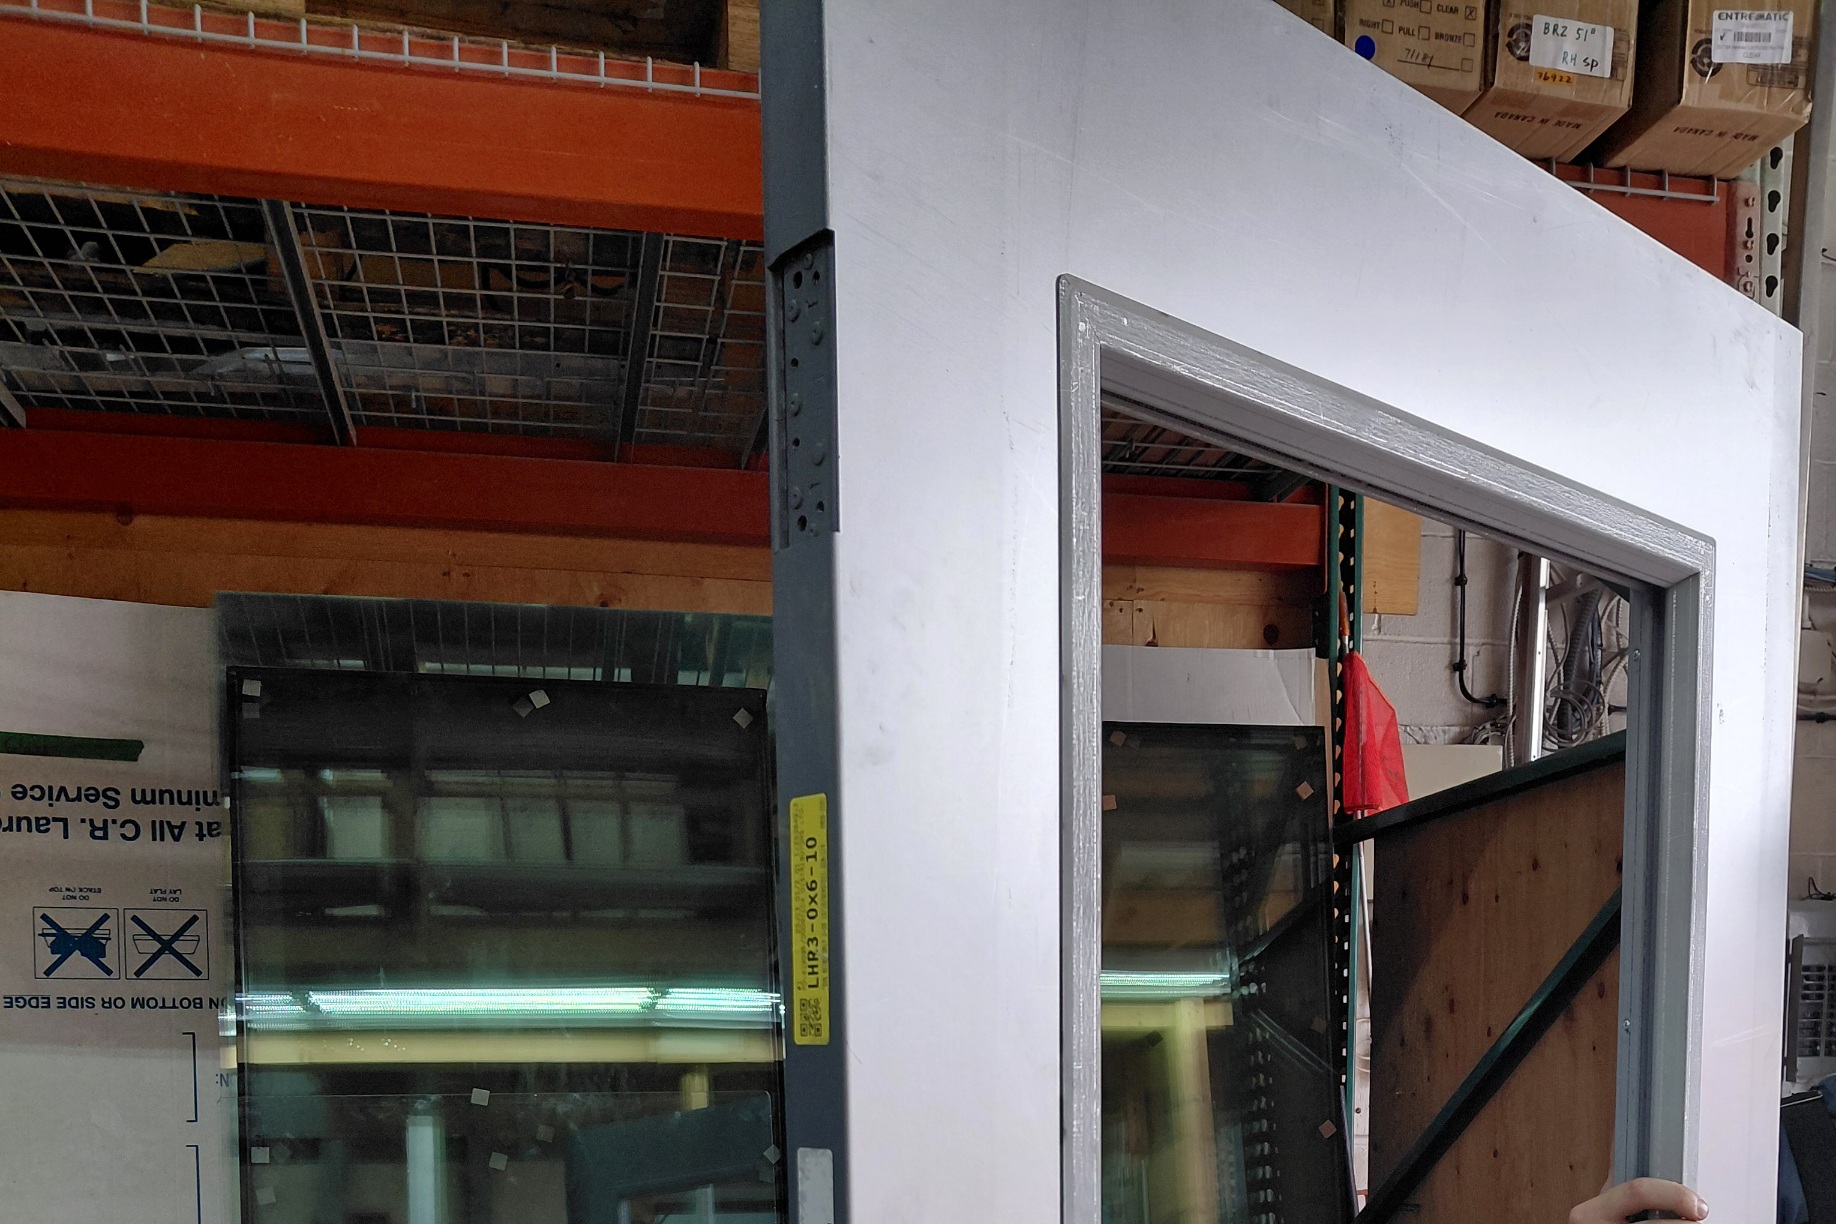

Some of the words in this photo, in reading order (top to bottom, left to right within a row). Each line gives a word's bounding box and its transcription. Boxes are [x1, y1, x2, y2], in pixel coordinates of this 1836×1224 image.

[1436, 4, 1459, 15] CLEAR
[1359, 18, 1381, 30] RIGHT
[1398, 26, 1416, 37] PULL
[1434, 31, 1463, 44] BRONZE
[1494, 111, 1536, 123] CANADA
[1552, 120, 1582, 129] MADE
[1673, 126, 1714, 136] CANADA
[1732, 132, 1760, 141] MADE
[11, 783, 121, 810] Service
[0, 815, 69, 840] Laur
[80, 818, 141, 842] C.R.
[151, 820, 187, 842] All
[2, 995, 50, 1009] EDGE
[57, 996, 96, 1010] SIDE
[101, 996, 126, 1010] OR
[131, 996, 204, 1010] BOTTOM
